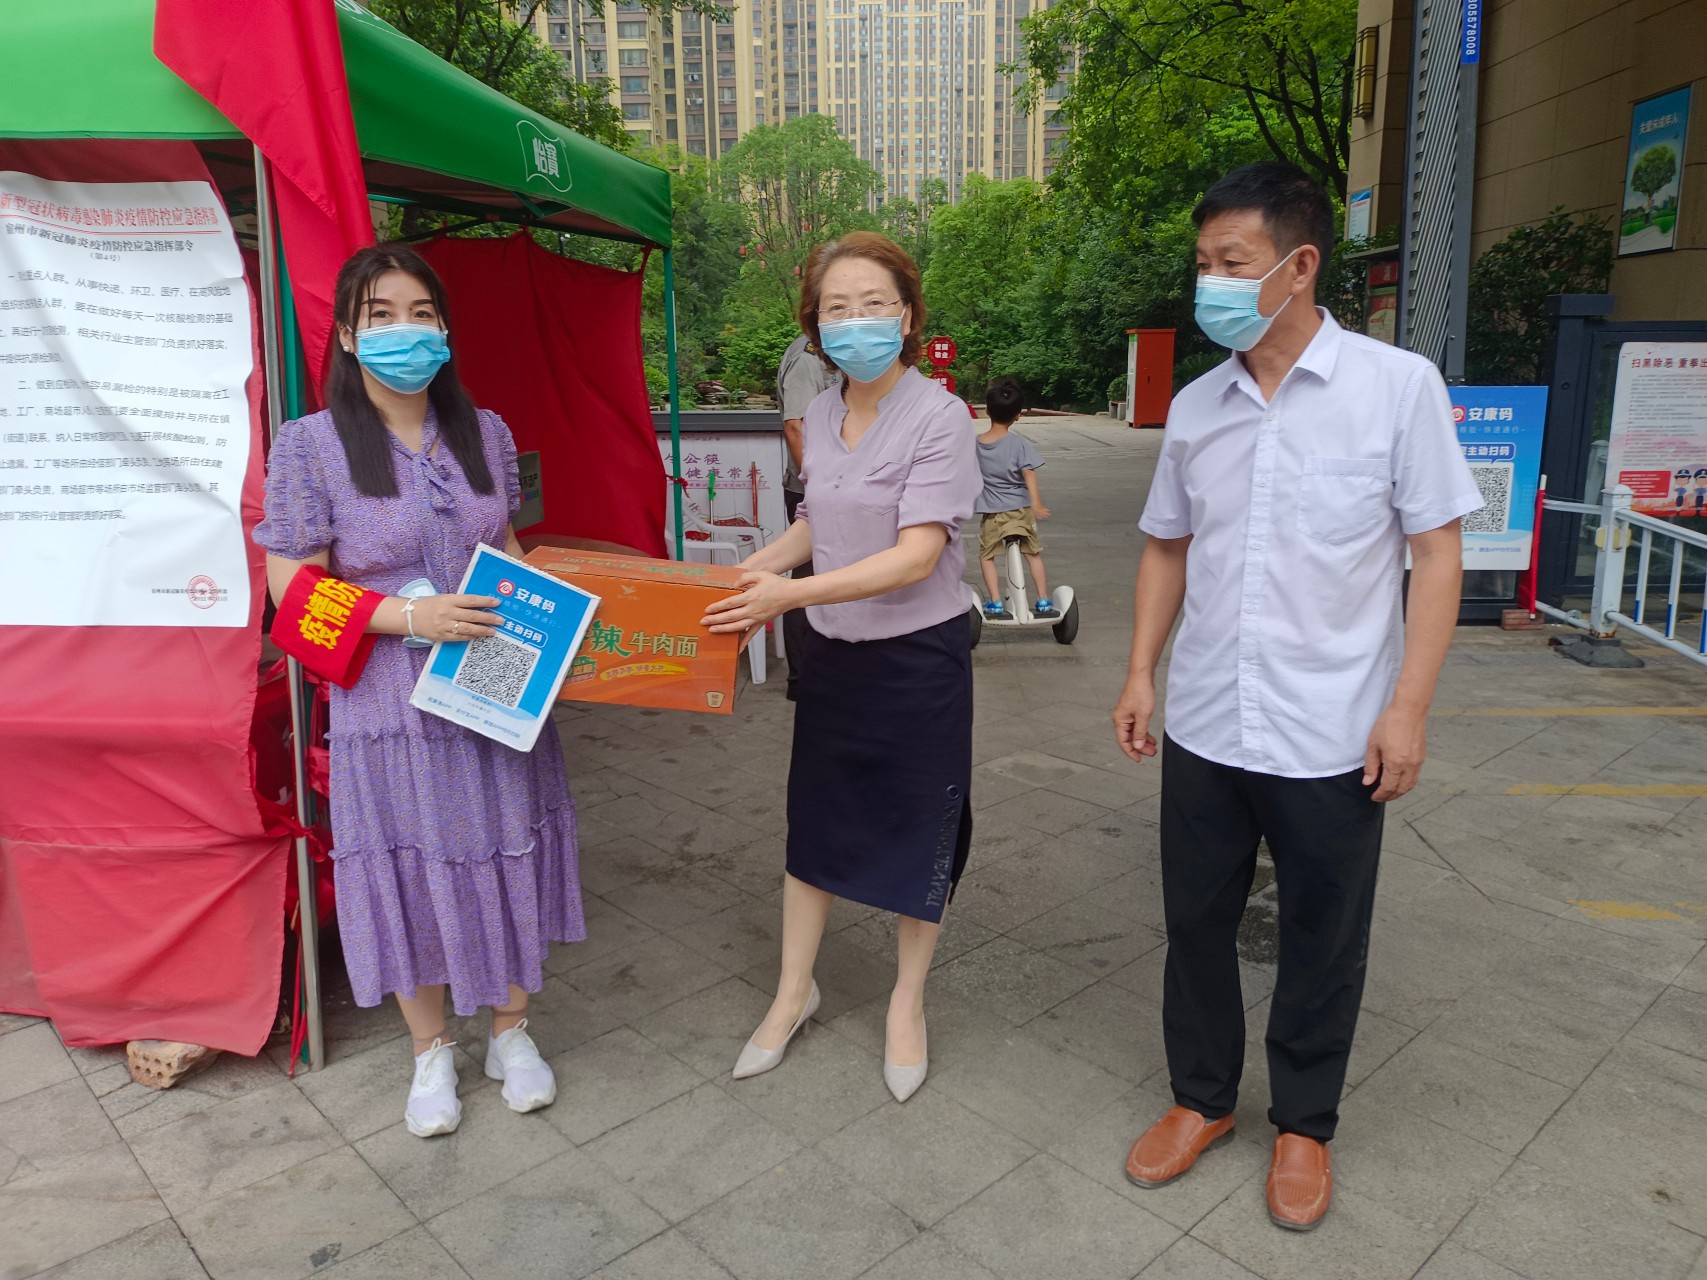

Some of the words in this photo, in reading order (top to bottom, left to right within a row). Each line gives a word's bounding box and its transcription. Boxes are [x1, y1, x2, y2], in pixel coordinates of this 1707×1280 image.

[1468, 407, 1513, 421] 安康码
[298, 578, 366, 650] 疫情防
[516, 587, 557, 614] 安康码
[628, 631, 700, 659] 牛肉面
